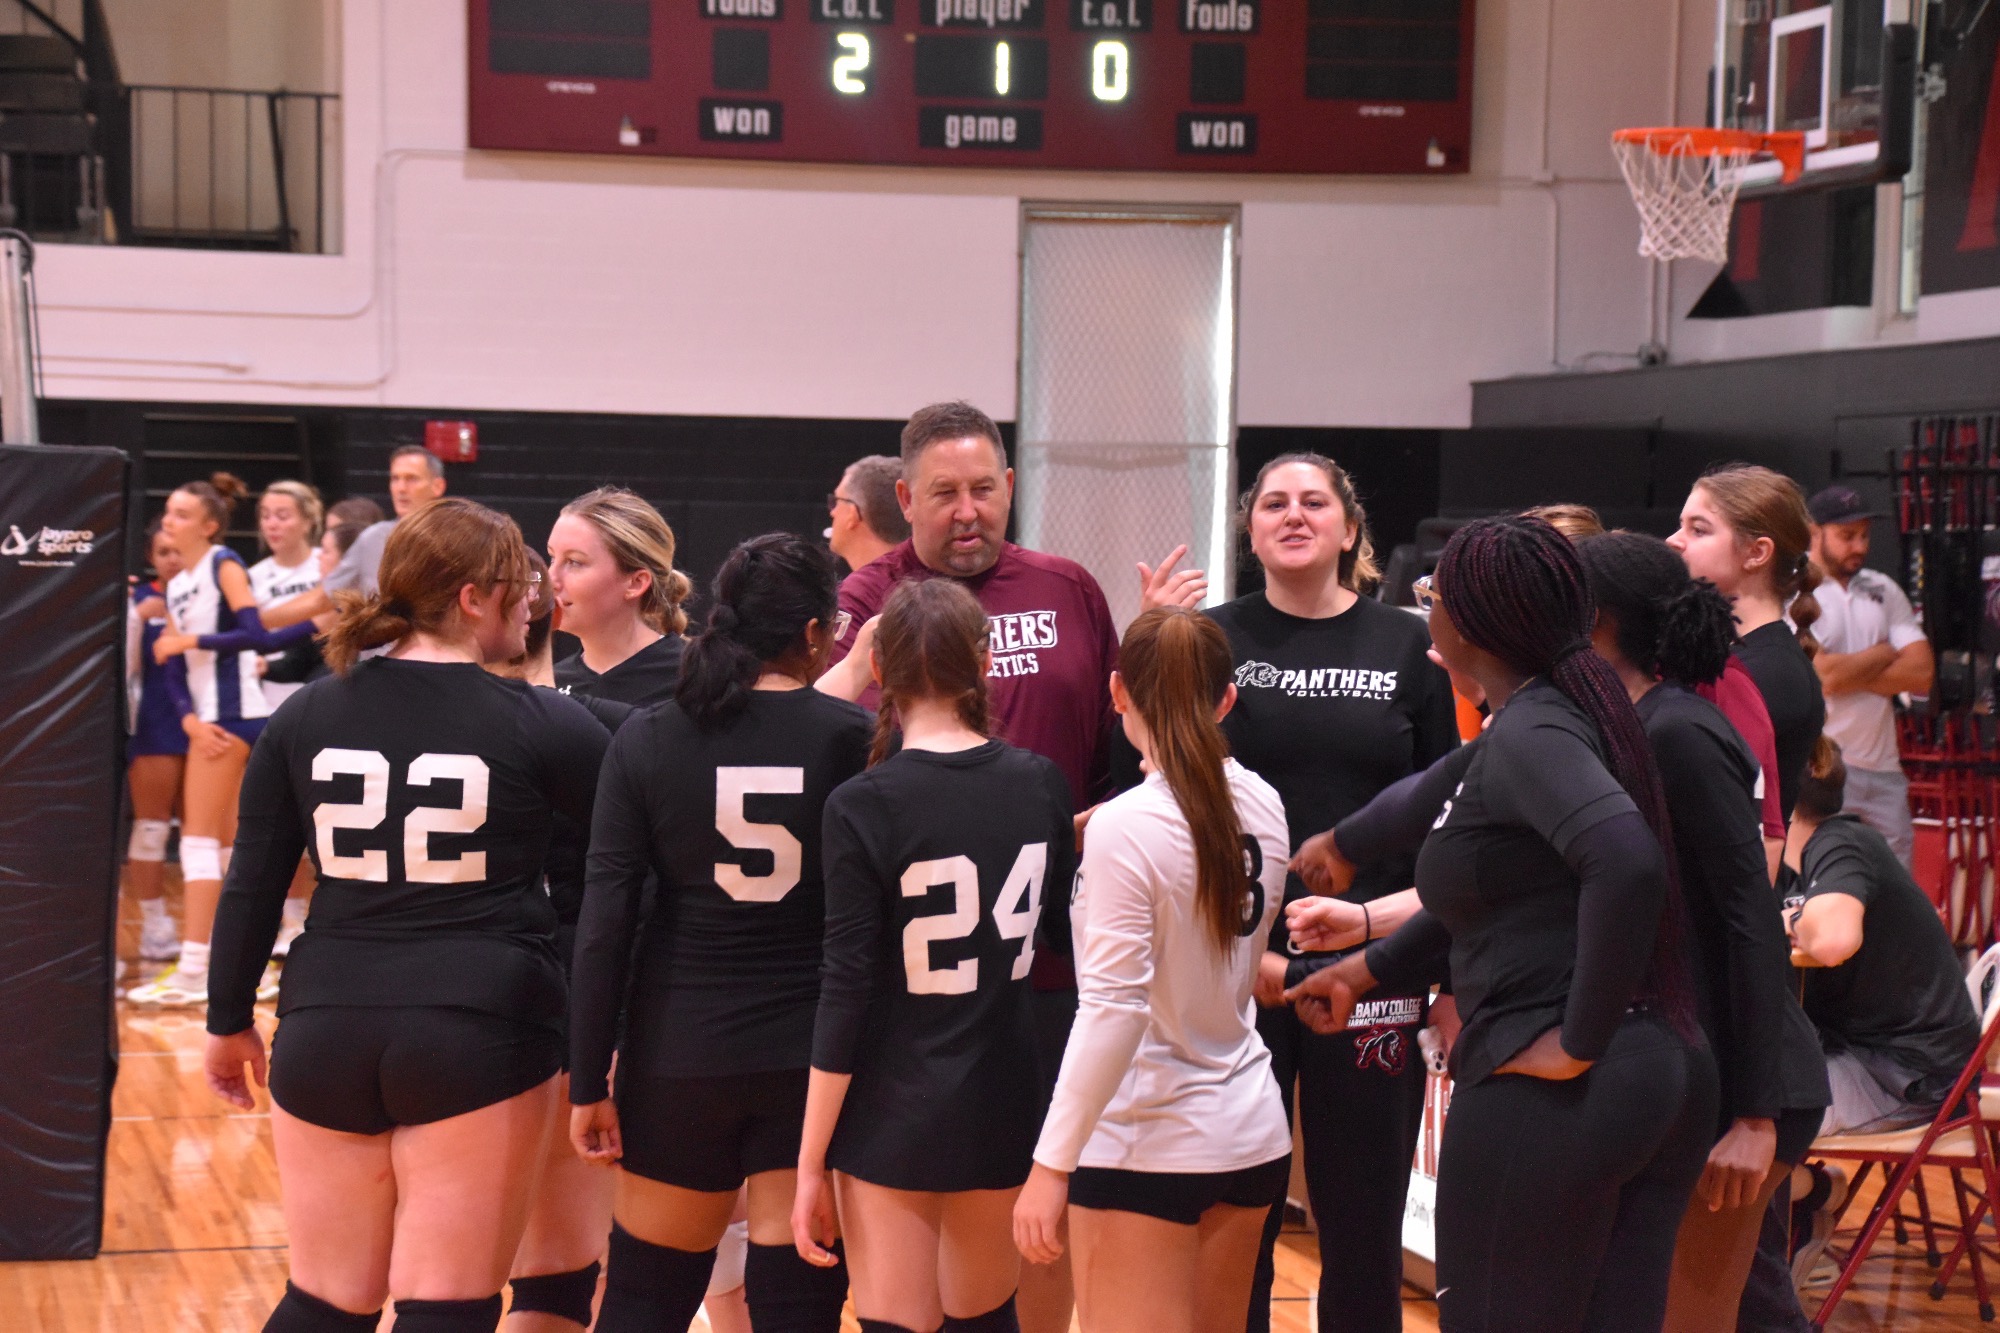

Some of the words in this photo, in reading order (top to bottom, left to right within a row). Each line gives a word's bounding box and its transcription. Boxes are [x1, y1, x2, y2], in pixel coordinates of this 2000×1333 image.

[936, 0, 1028, 27] player
[1187, 0, 1253, 31] fouls
[832, 33, 870, 93] 2
[994, 42, 1010, 95] 1
[1092, 41, 1128, 100] 0
[714, 107, 770, 135] won
[944, 114, 1018, 148] game
[1190, 120, 1245, 147] won
[38, 541, 93, 555] sports
[1279, 668, 1398, 692] PANTHERS
[1286, 689, 1392, 700] VOLLEYBALL
[312, 747, 490, 884] 22
[714, 766, 804, 902] 5
[900, 842, 1048, 995] 24
[1350, 1001, 1388, 1018] BANY
